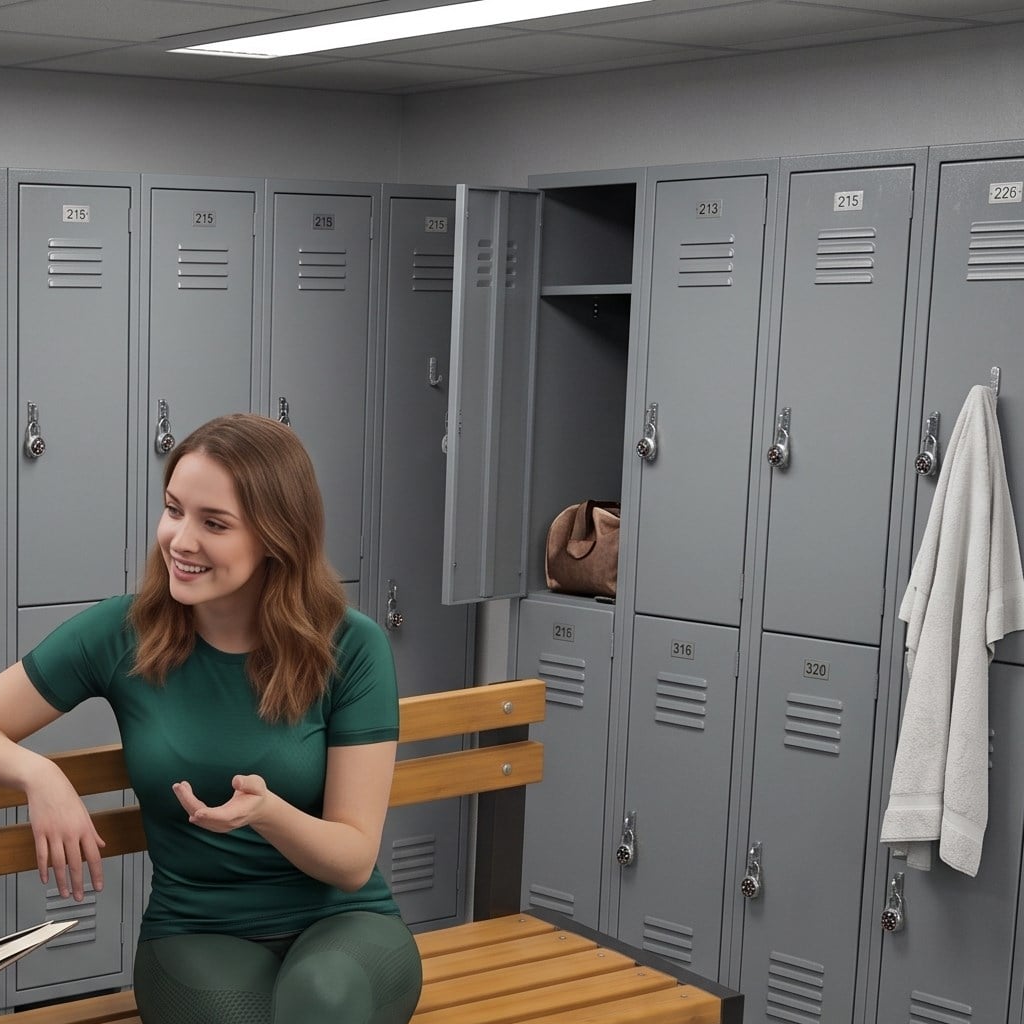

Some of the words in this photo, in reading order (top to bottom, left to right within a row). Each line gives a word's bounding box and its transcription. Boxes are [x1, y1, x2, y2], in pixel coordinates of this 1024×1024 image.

[994, 187, 1018, 199] 226
[838, 195, 859, 208] 215
[67, 209, 87, 219] 215
[700, 203, 719, 215] 213
[196, 213, 214, 223] 215
[428, 220, 445, 230] 215
[673, 643, 693, 655] 316
[806, 662, 827, 676] 320
